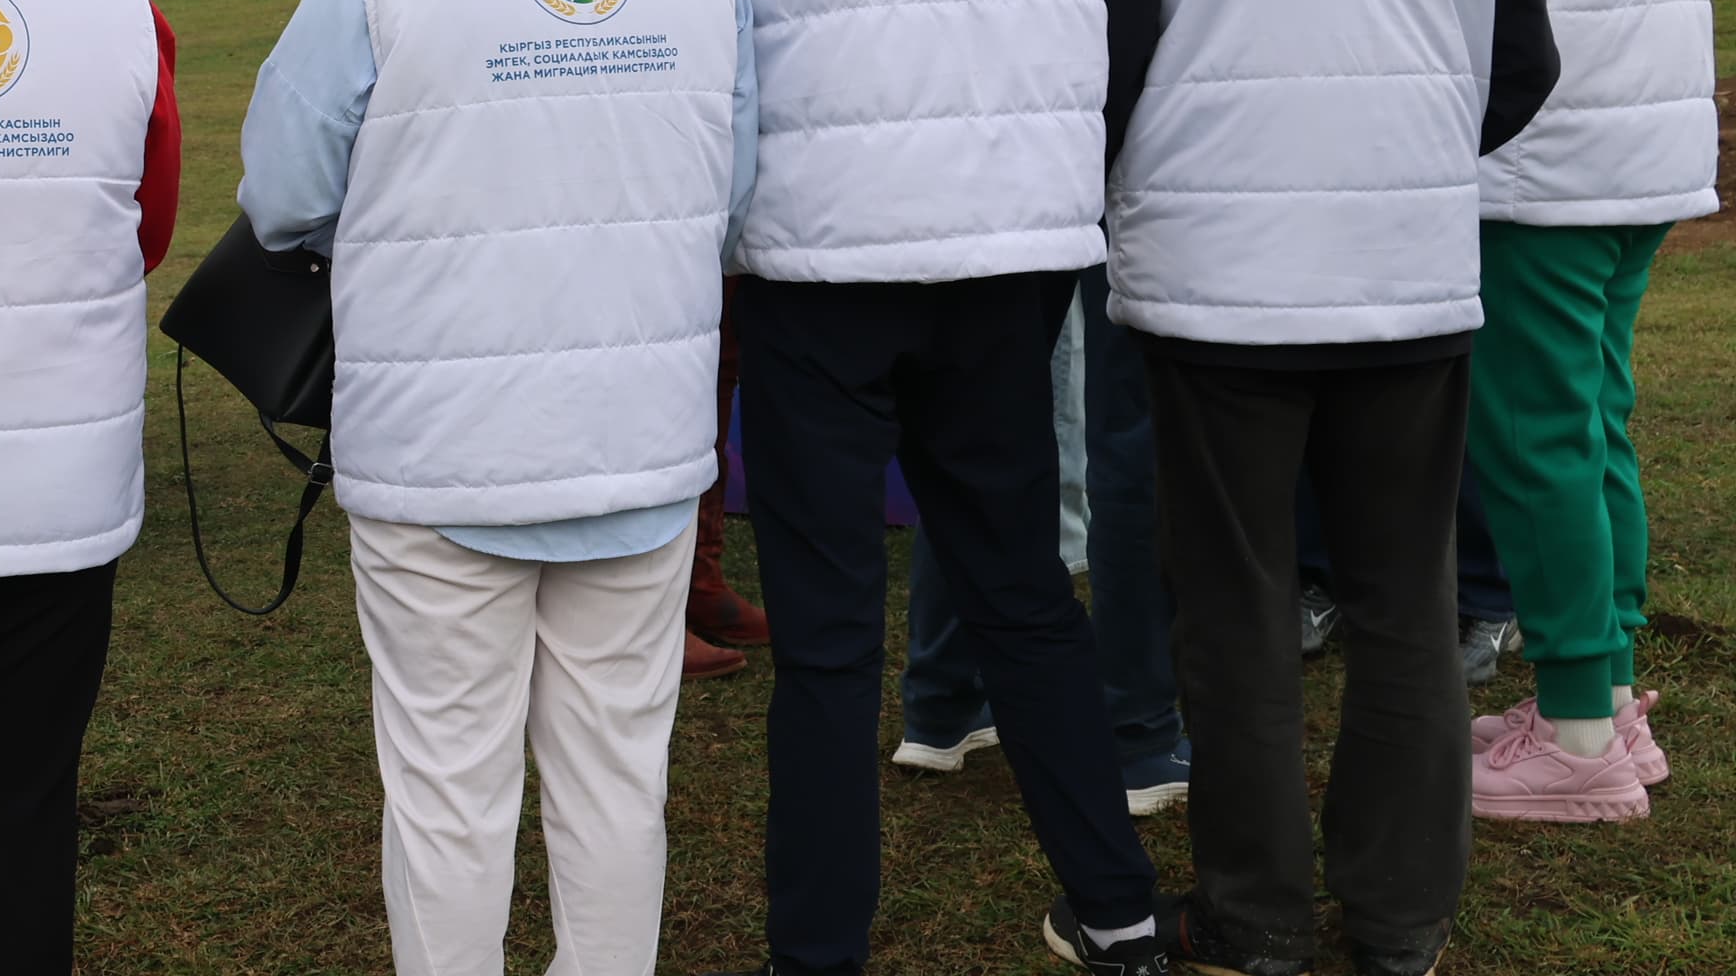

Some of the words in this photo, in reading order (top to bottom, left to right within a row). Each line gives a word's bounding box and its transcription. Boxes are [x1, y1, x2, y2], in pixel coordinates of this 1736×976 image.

[500, 40, 552, 53] КЫРГЫЗ
[556, 35, 666, 49] РЕСПУБЛИКАСЫНЫН
[486, 57, 530, 68] ЭМГЕК,
[534, 51, 609, 65] СОЦИАЛДЫК
[613, 48, 678, 60] КАМСЫЗДОО
[492, 71, 530, 82] ЖАНА
[534, 66, 598, 79] МИГРАЦИЯ
[600, 62, 675, 74] МИНИСТРЛИГИ
